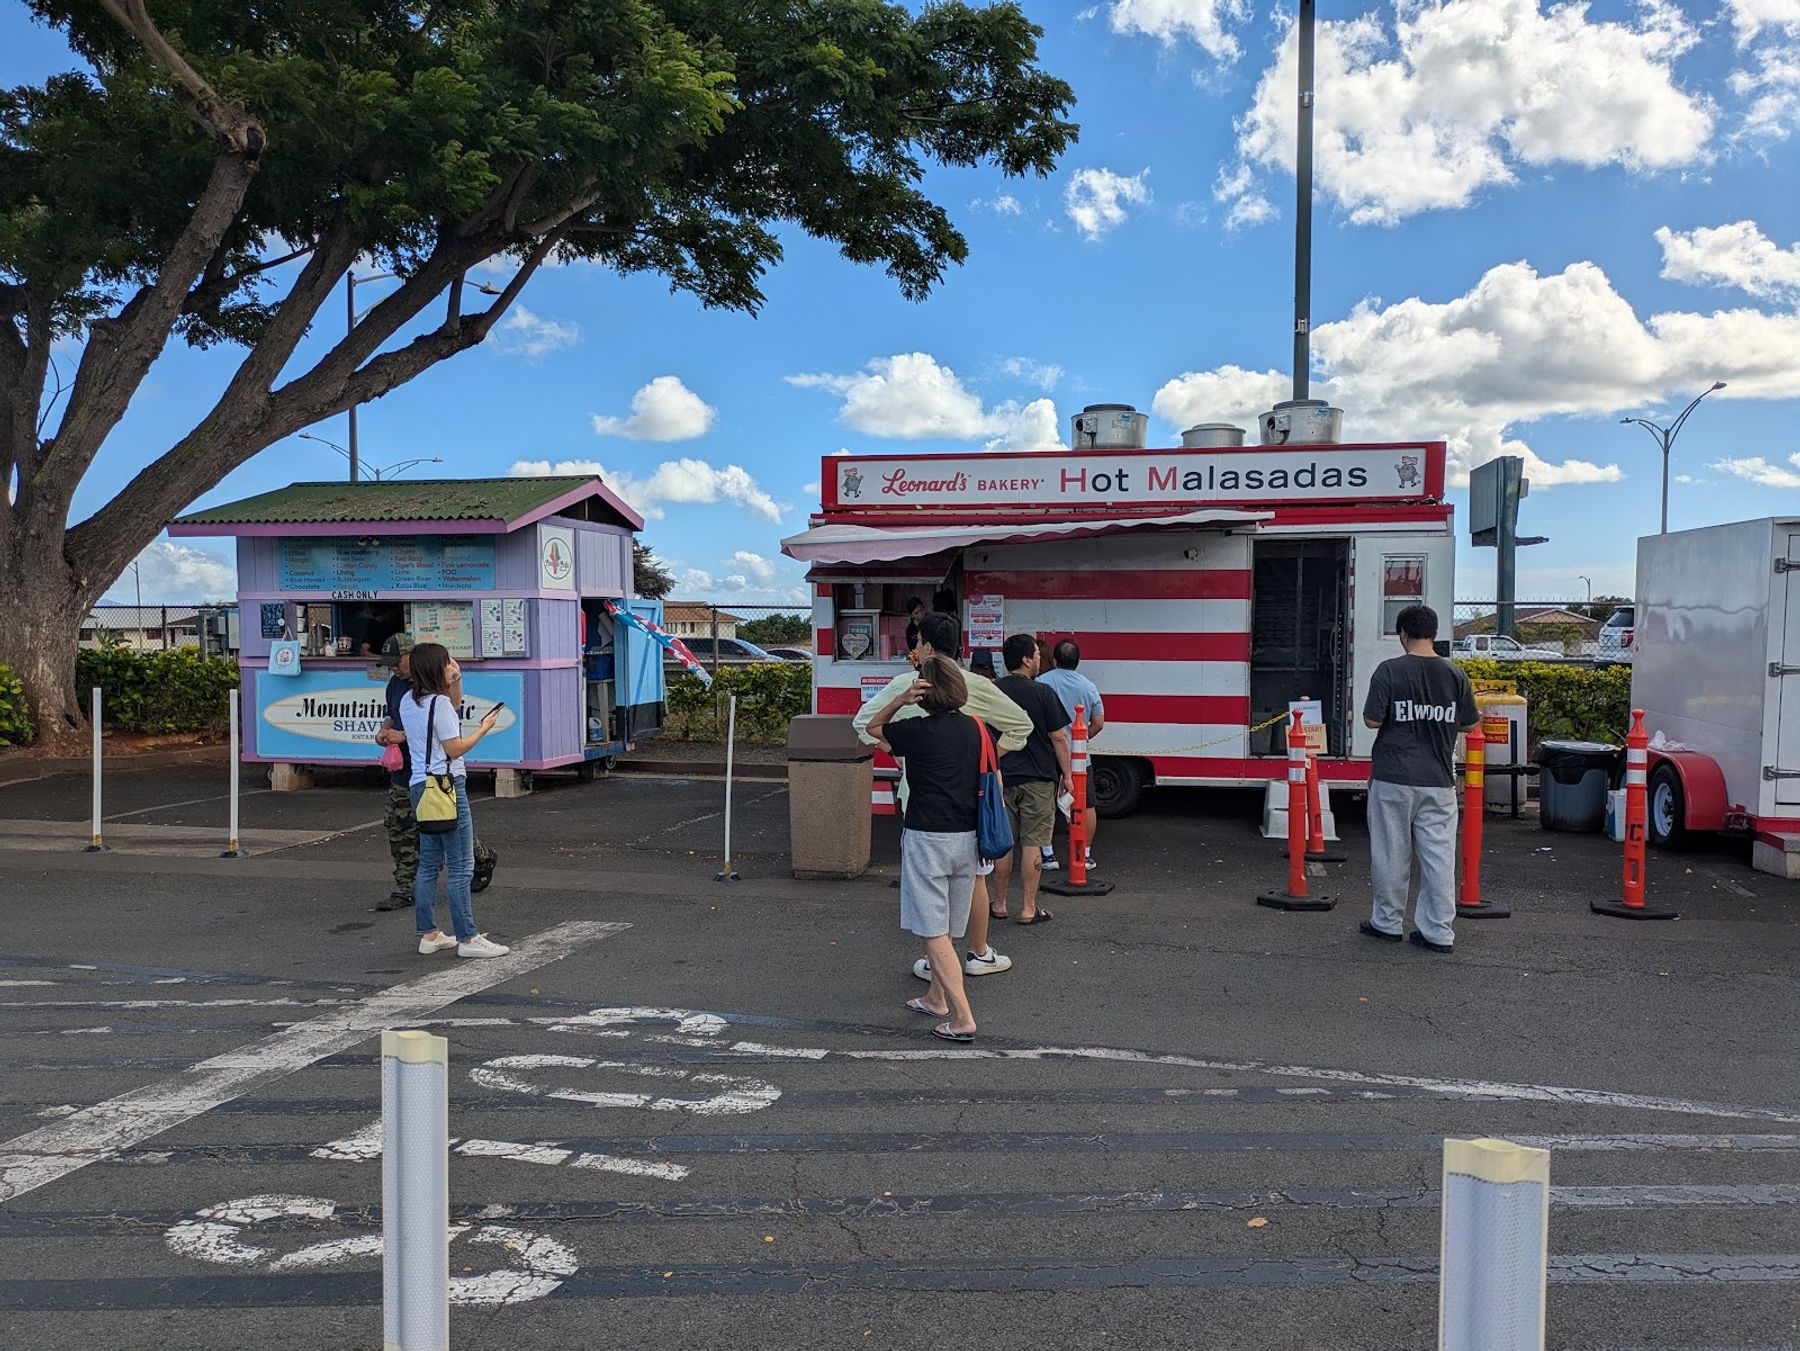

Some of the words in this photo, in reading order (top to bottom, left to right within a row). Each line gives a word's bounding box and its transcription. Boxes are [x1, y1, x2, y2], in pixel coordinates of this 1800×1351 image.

[881, 467, 968, 496] Leonard's
[977, 479, 1039, 491] BAKERY
[1060, 467, 1130, 493] Hot
[1148, 462, 1368, 491] Malasadas
[331, 590, 354, 600] CASH
[356, 590, 379, 599] ONLY
[296, 697, 387, 719] Mountain
[1394, 699, 1457, 723] Elwood
